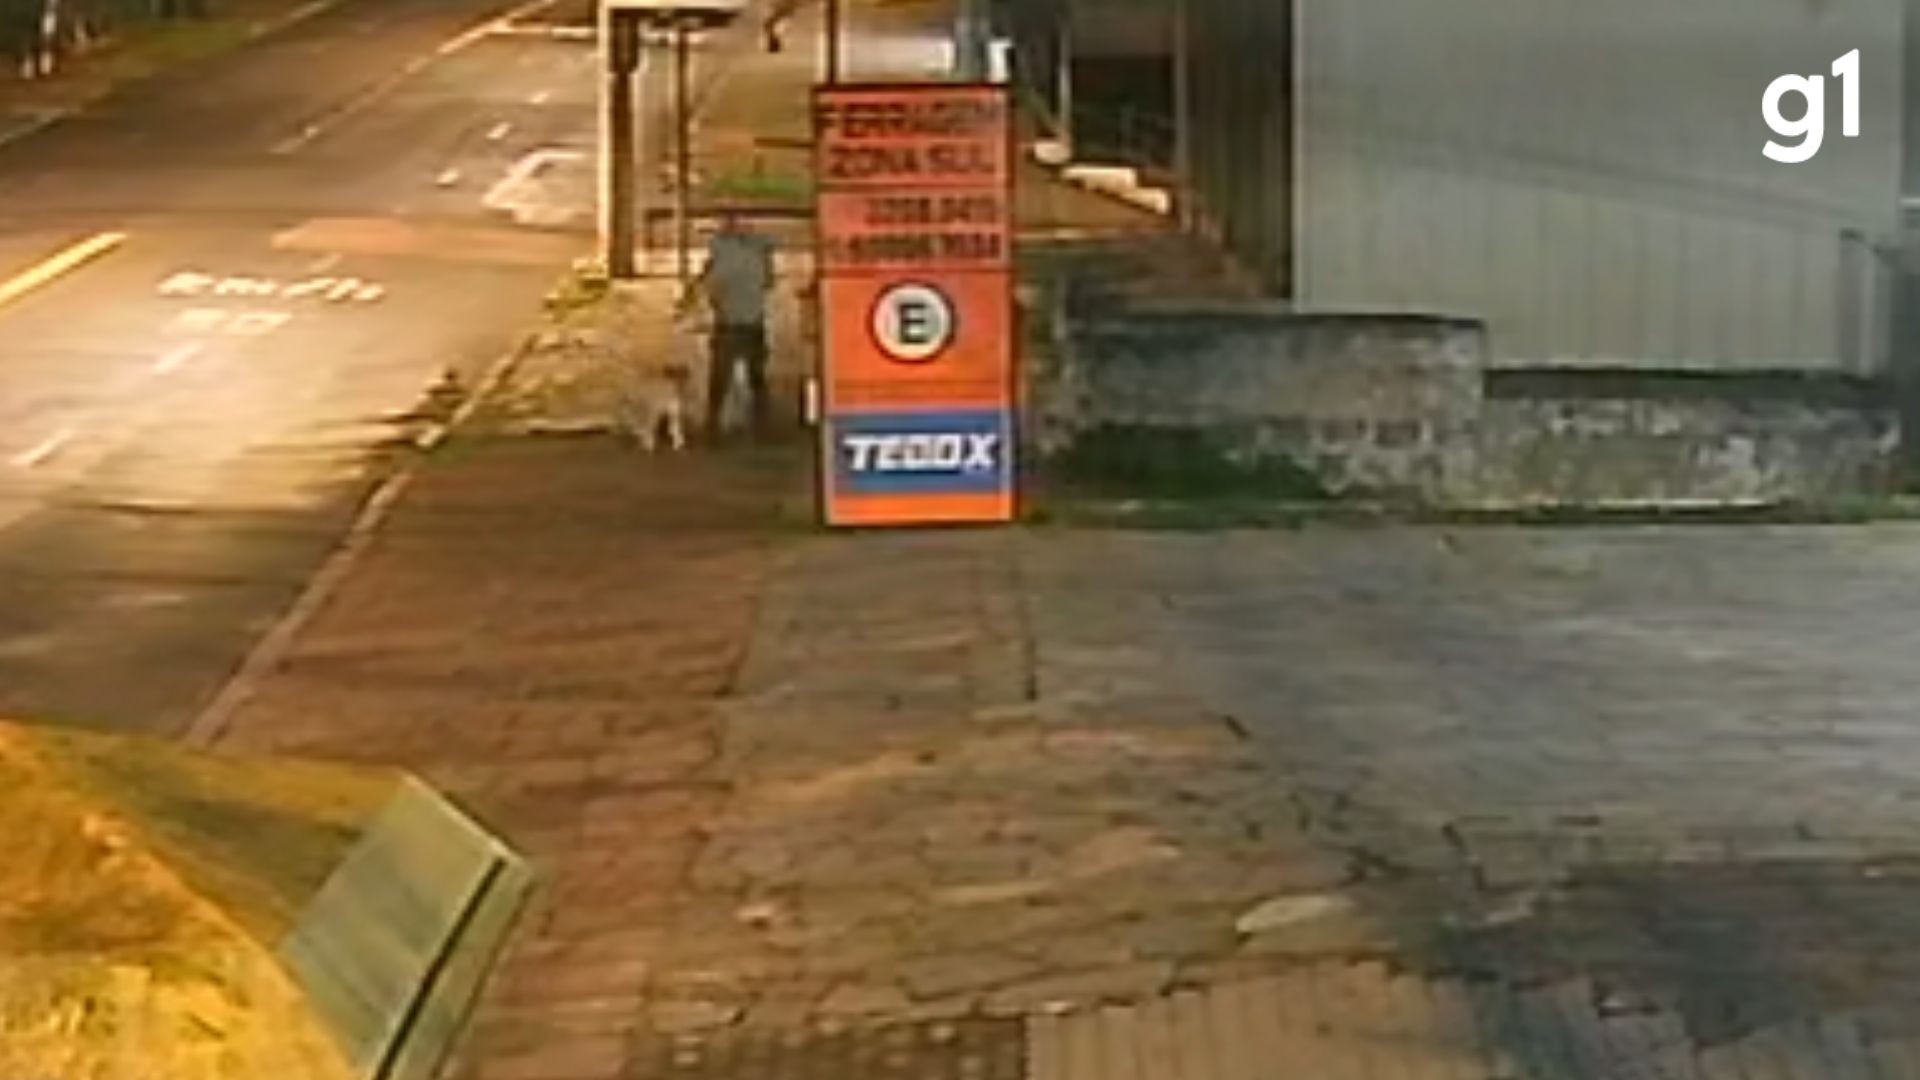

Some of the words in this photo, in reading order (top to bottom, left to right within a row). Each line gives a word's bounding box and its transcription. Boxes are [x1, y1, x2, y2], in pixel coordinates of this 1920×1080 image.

[829, 145, 919, 177] ZONA
[927, 145, 995, 174] SUL
[897, 302, 930, 344] E
